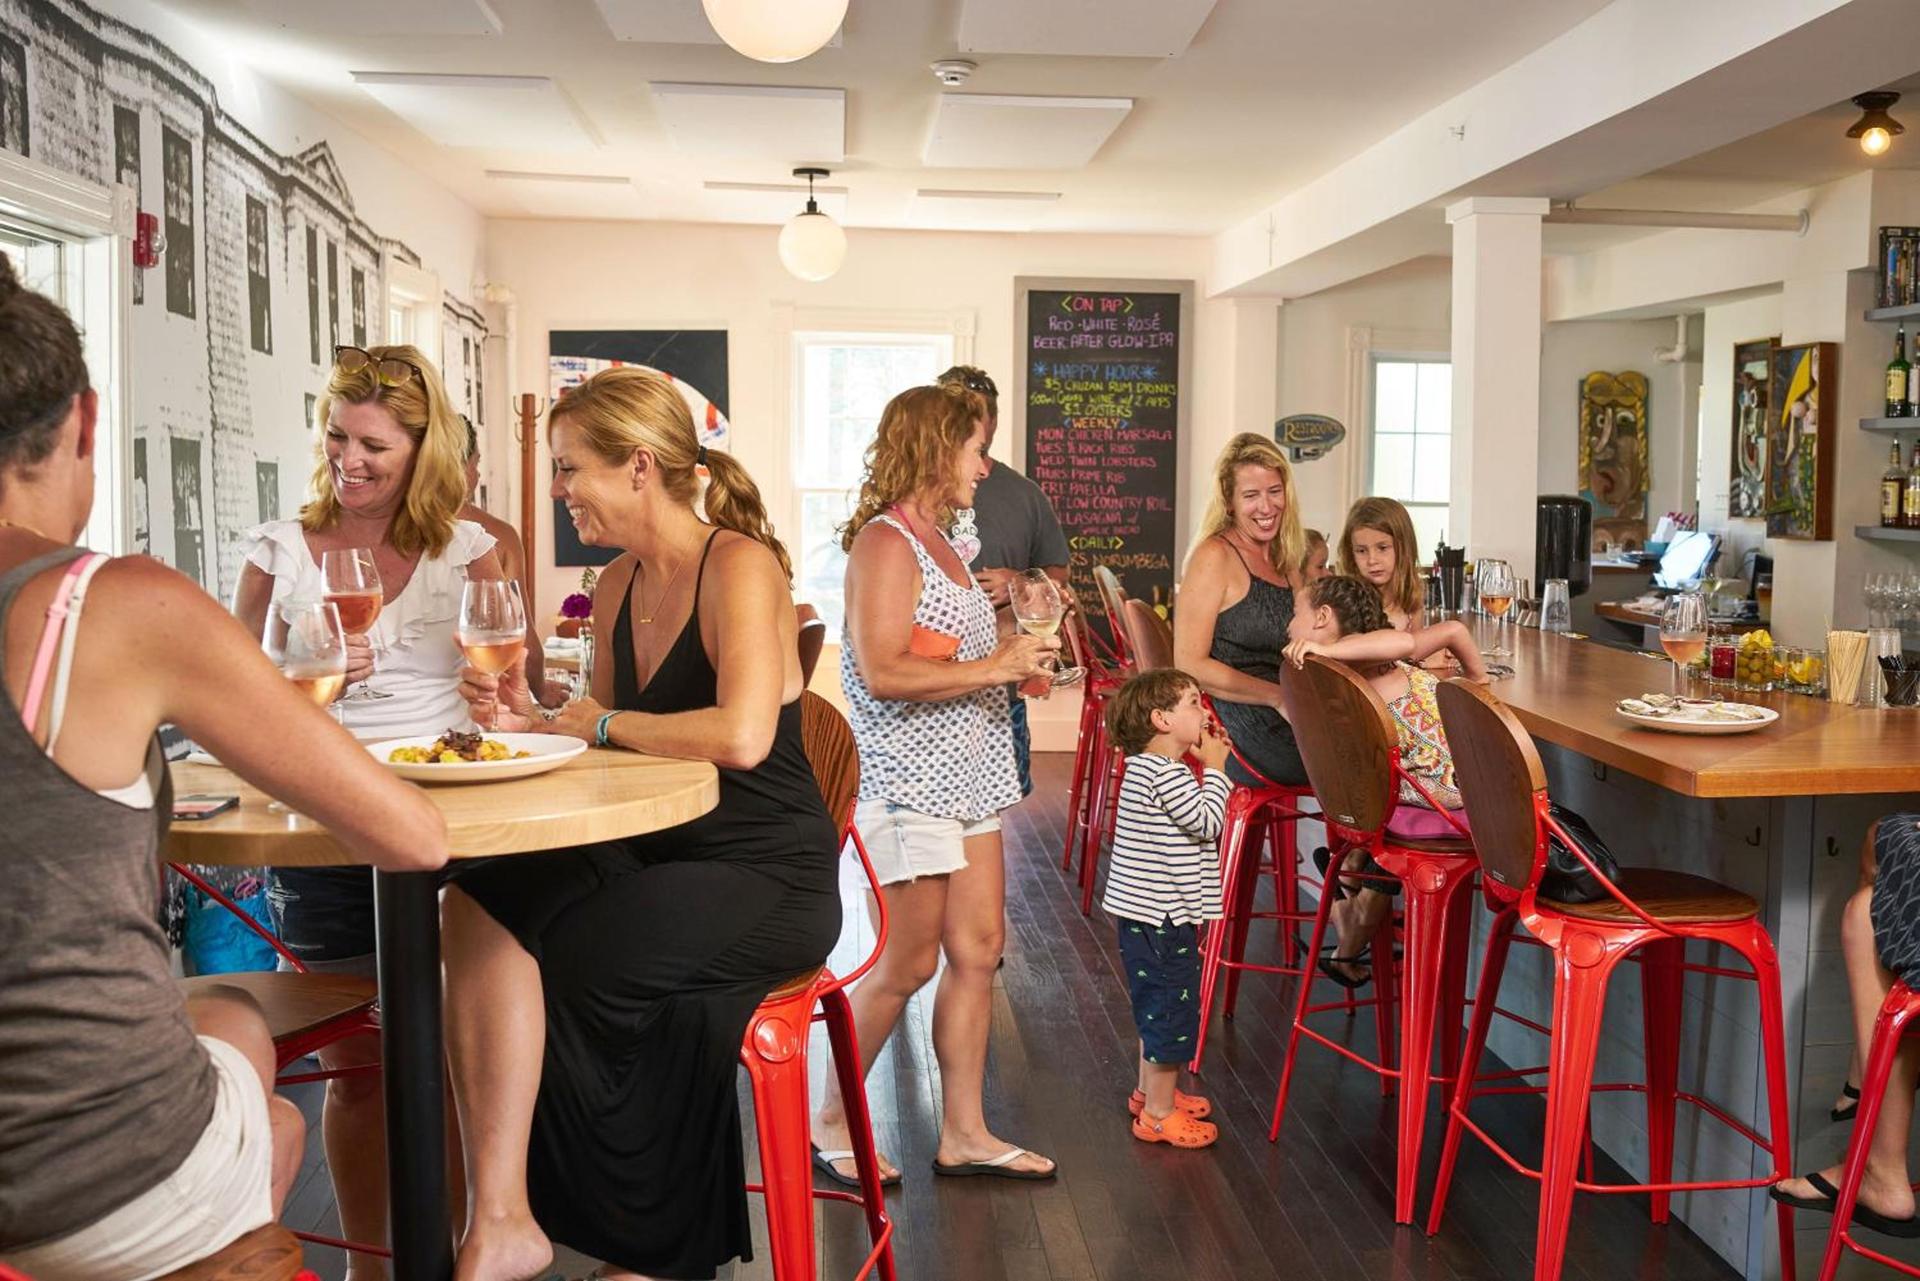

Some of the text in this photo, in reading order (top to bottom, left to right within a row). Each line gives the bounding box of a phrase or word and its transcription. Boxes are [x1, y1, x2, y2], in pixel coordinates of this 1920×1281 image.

[1073, 297, 1123, 312] ON TAP
[1083, 318, 1118, 331] WHITE
[1071, 334, 1103, 348] AFTER
[1054, 364, 1141, 380] HAPPY HOUR
[1085, 405, 1132, 417] OYSTERS
[1073, 418, 1119, 429] WEEKLY
[1071, 483, 1117, 495] PAELLA
[1067, 496, 1088, 509] LOW
[1093, 496, 1142, 509] COUNTRY
[1066, 512, 1122, 525] LASAGNA
[1079, 536, 1115, 549] DAILY
